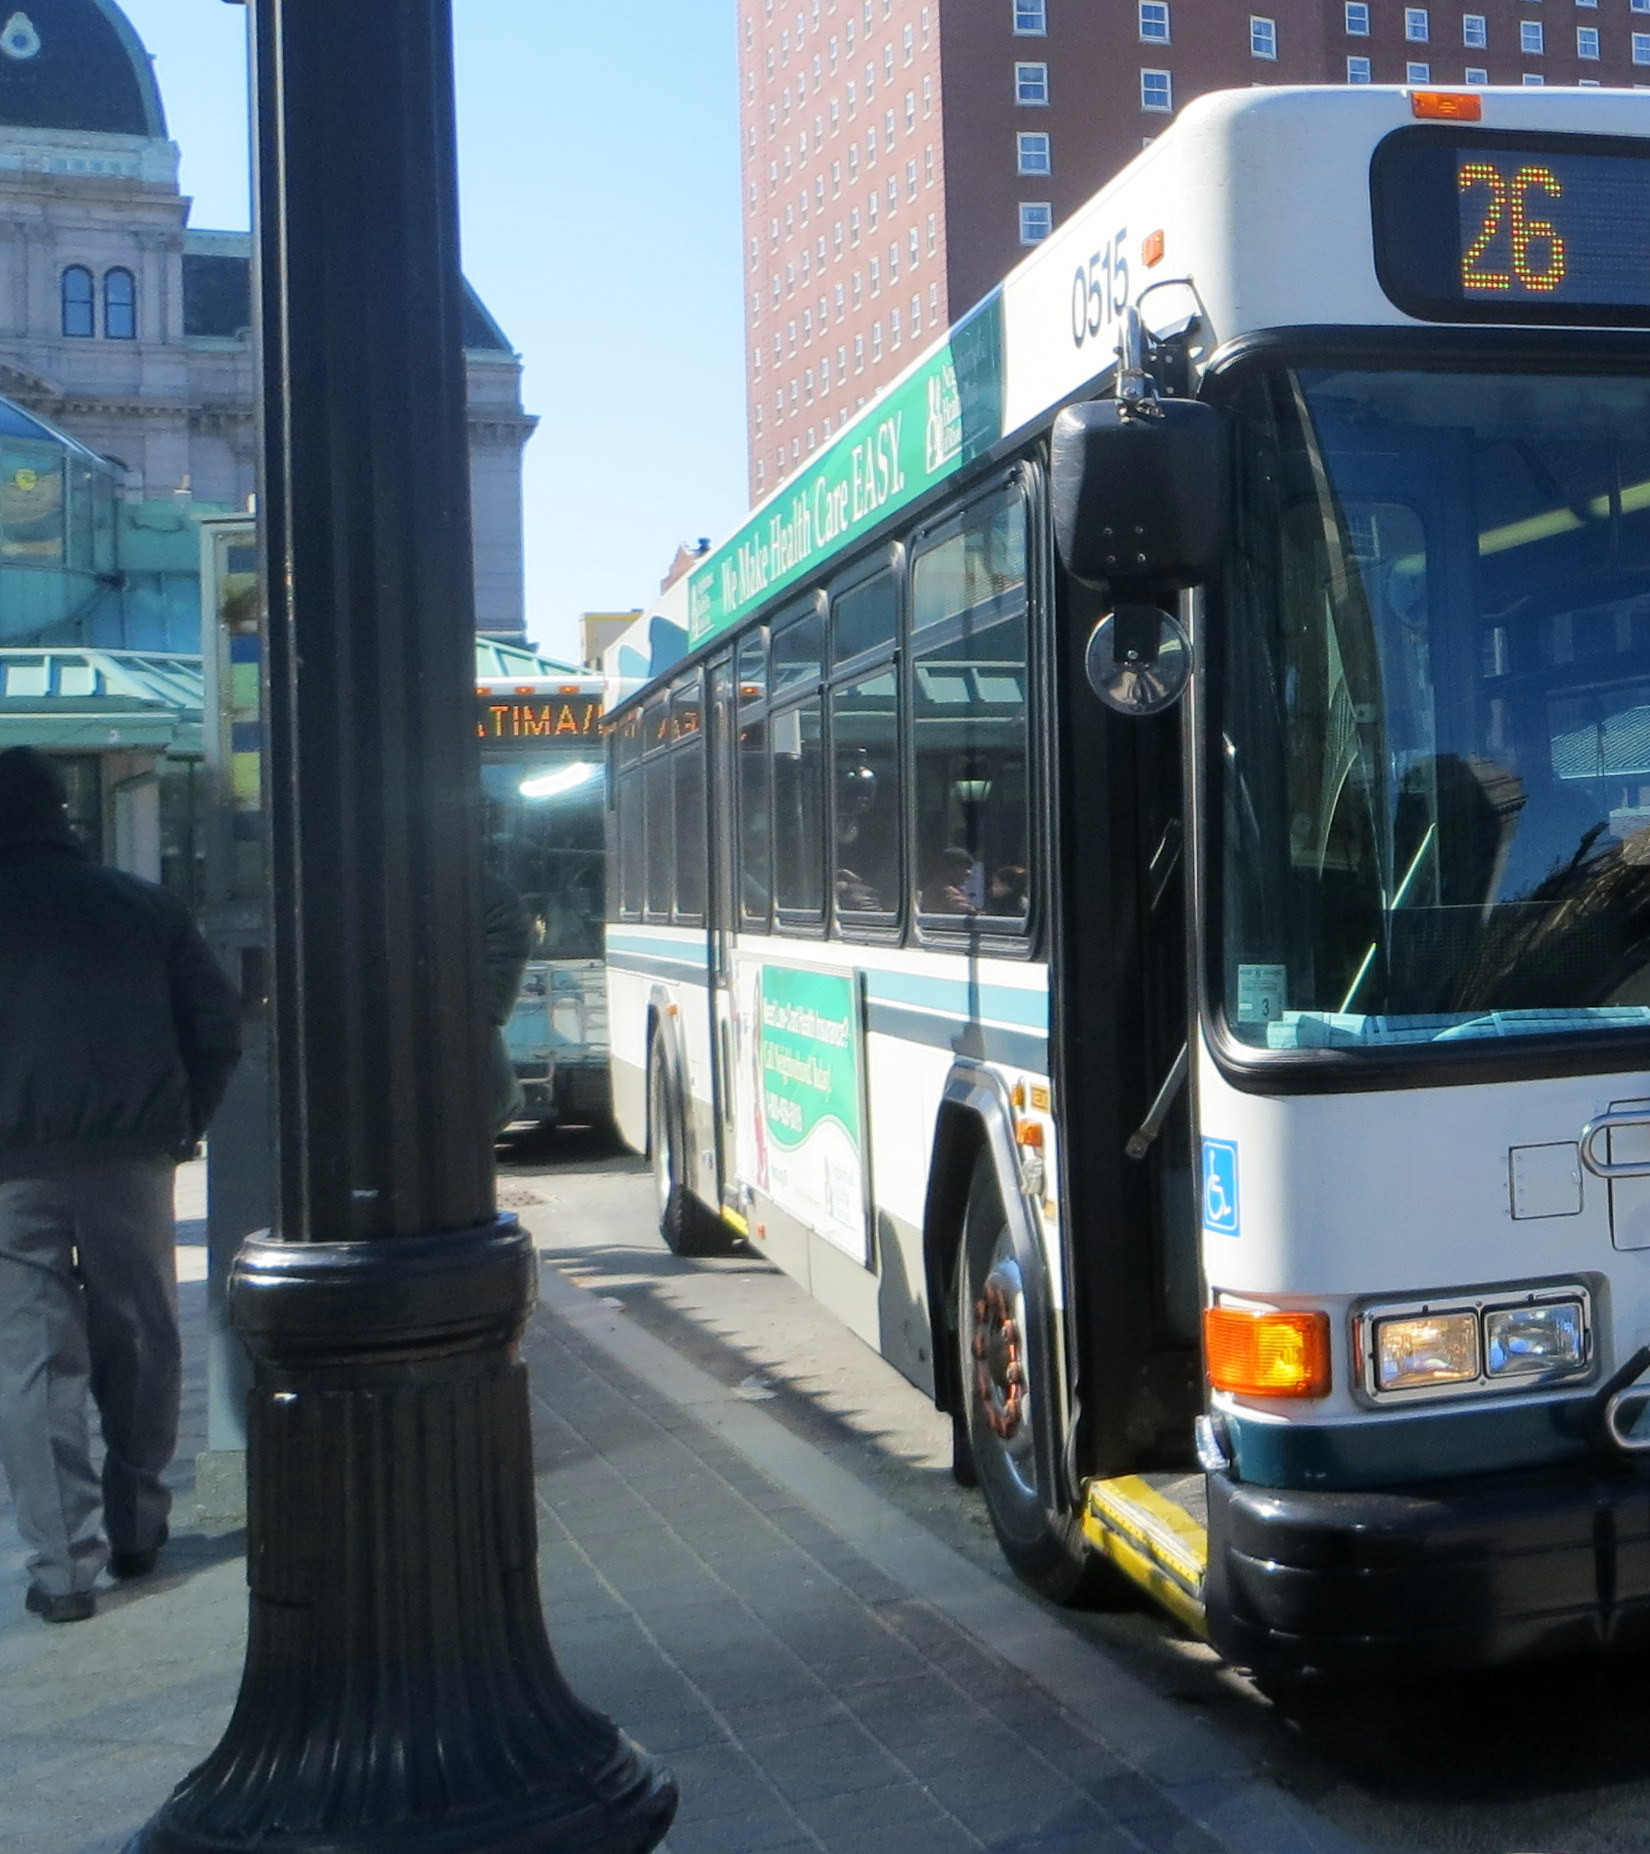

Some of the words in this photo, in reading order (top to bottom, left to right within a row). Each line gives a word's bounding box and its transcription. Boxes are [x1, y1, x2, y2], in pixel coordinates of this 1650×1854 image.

[1072, 226, 1129, 349] 0515
[1460, 163, 1565, 291] 26
[738, 531, 768, 605] Make
[769, 489, 812, 582] Health
[814, 475, 849, 548] Care
[852, 410, 905, 523] EASY.
